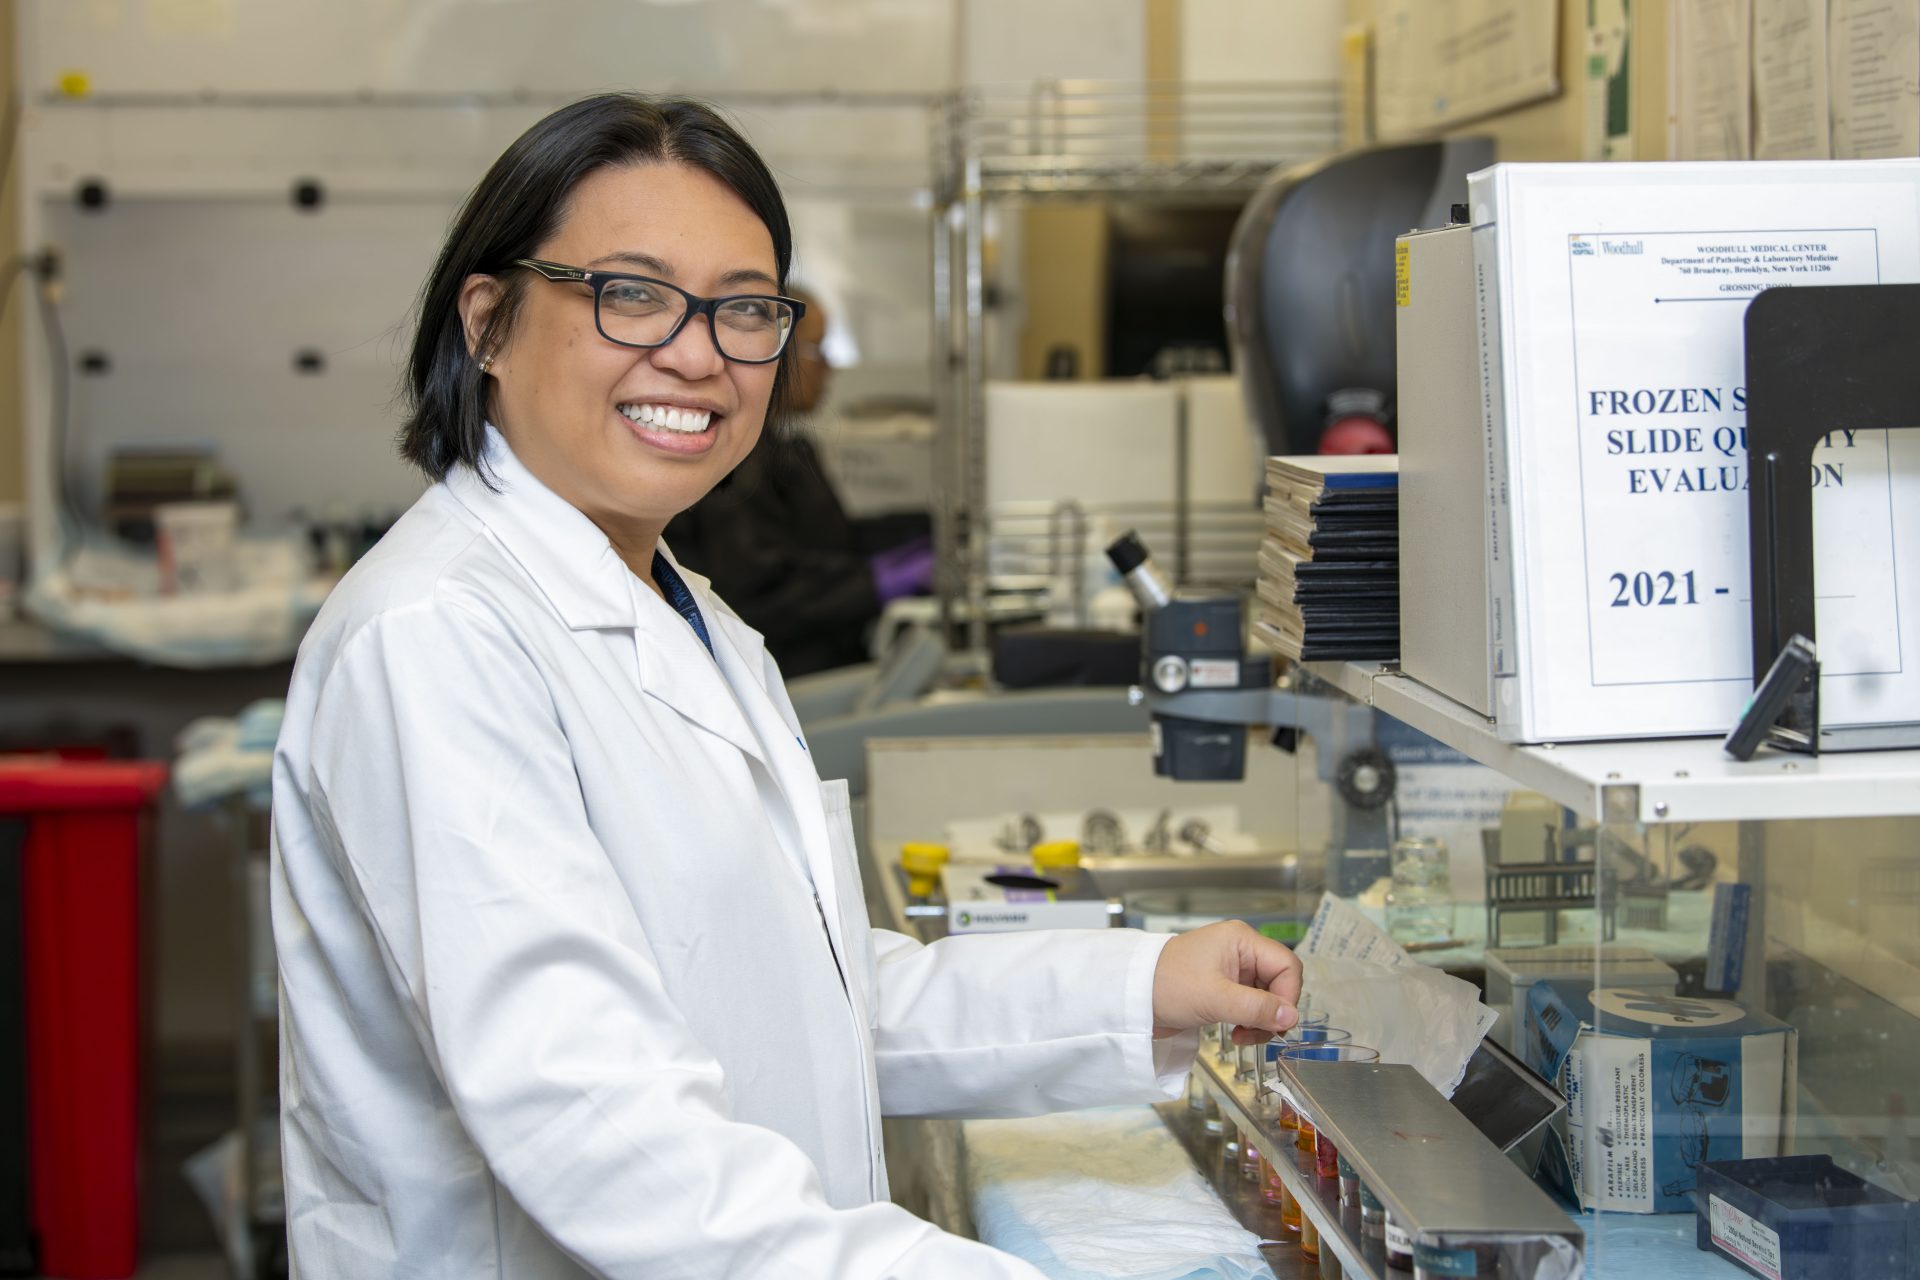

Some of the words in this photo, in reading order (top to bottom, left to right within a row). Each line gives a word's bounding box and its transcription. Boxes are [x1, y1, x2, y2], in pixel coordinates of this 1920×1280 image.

[1601, 240, 1644, 255] Woodhull
[1660, 257, 1704, 266] Department
[1715, 256, 1751, 265] Pathology
[1762, 255, 1804, 264] Laboratory
[1805, 253, 1839, 262] Medicine
[1697, 245, 1748, 254] WOODHULL
[1750, 244, 1791, 253] MEDICAL
[1791, 244, 1828, 253] CENTER
[1693, 265, 1732, 275] Broadway,
[1734, 264, 1770, 274] Brooklyn,
[1771, 264, 1788, 273] New
[1789, 264, 1809, 273] York
[1809, 264, 1831, 272] 11206
[1719, 283, 1764, 292] GROSSING
[1588, 388, 1722, 416] FROZEN
[1607, 428, 1703, 455] SLIDE
[1628, 463, 1845, 494] EVALUN
[1609, 570, 1701, 607] 2021
[1565, 1054, 1573, 1117] PARAFILM
[1607, 1151, 1615, 1197] PARAFILM
